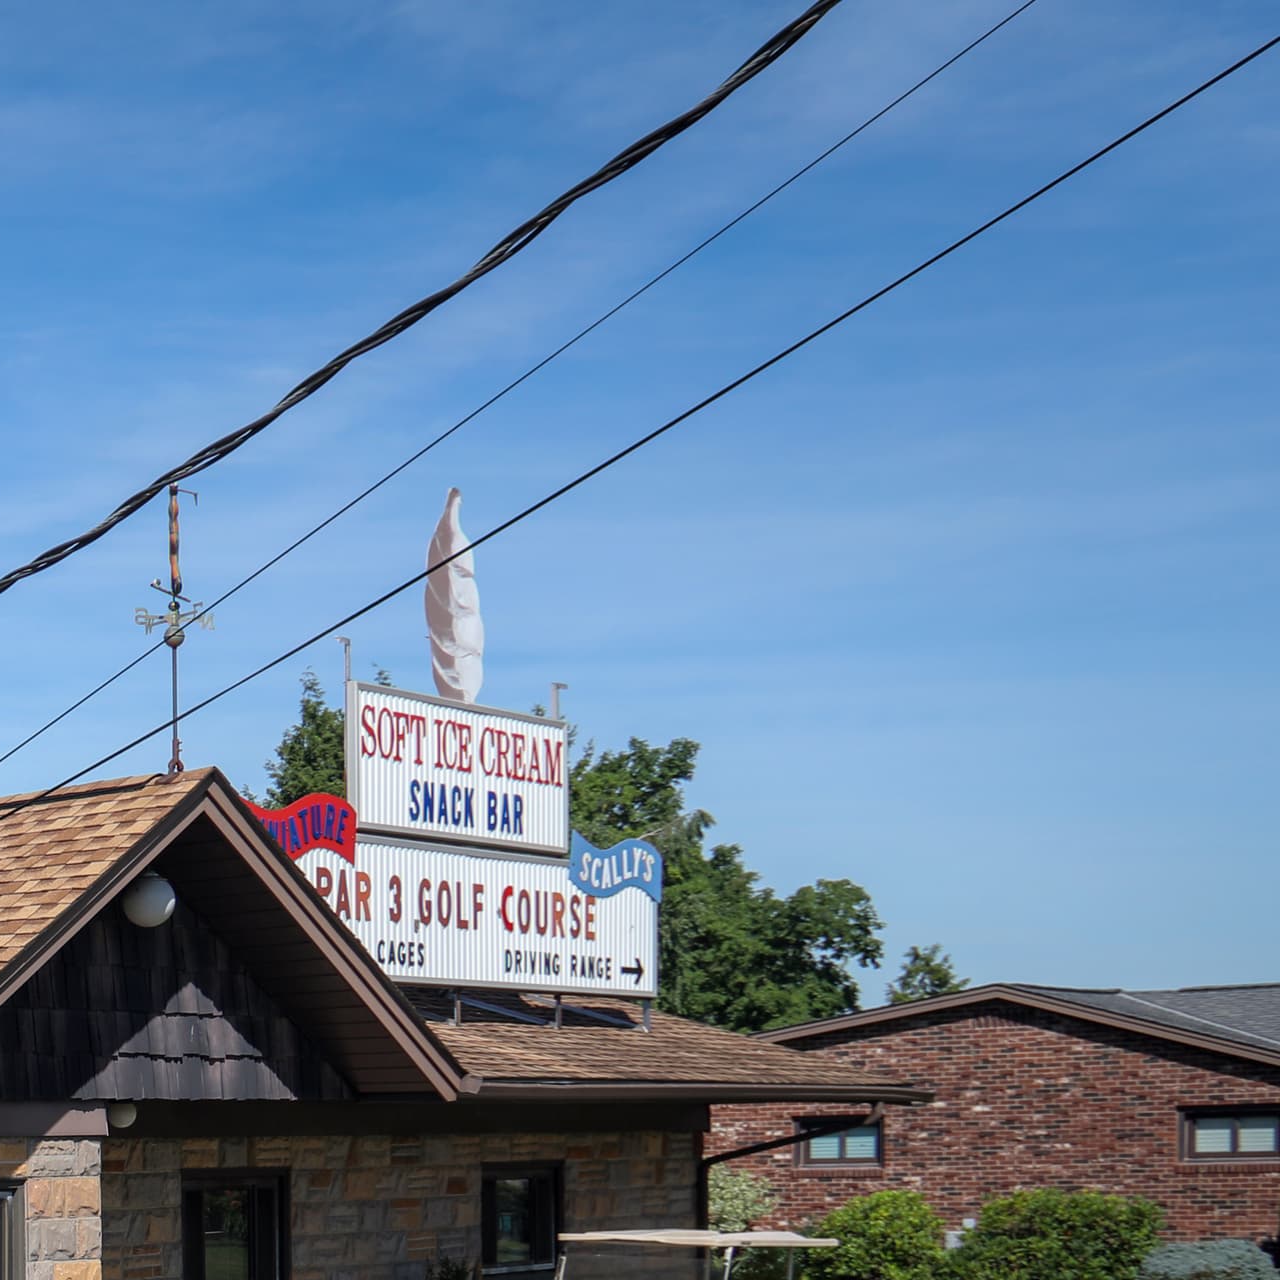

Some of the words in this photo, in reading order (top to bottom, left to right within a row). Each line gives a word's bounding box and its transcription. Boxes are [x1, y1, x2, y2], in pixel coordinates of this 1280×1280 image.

[360, 704, 426, 766] SOFT
[434, 719, 472, 774] ICE
[479, 726, 564, 788] CREAM
[408, 779, 475, 828] SNACK
[487, 790, 524, 836] BAR
[578, 846, 656, 890] SCALLY'S
[315, 866, 372, 922] PAR
[388, 874, 403, 924] 3
[418, 877, 485, 932] GOLF
[500, 885, 597, 941] COURSE
[376, 939, 425, 968] CAGES
[504, 949, 561, 977] DRIVING
[570, 952, 613, 981] RANGE
